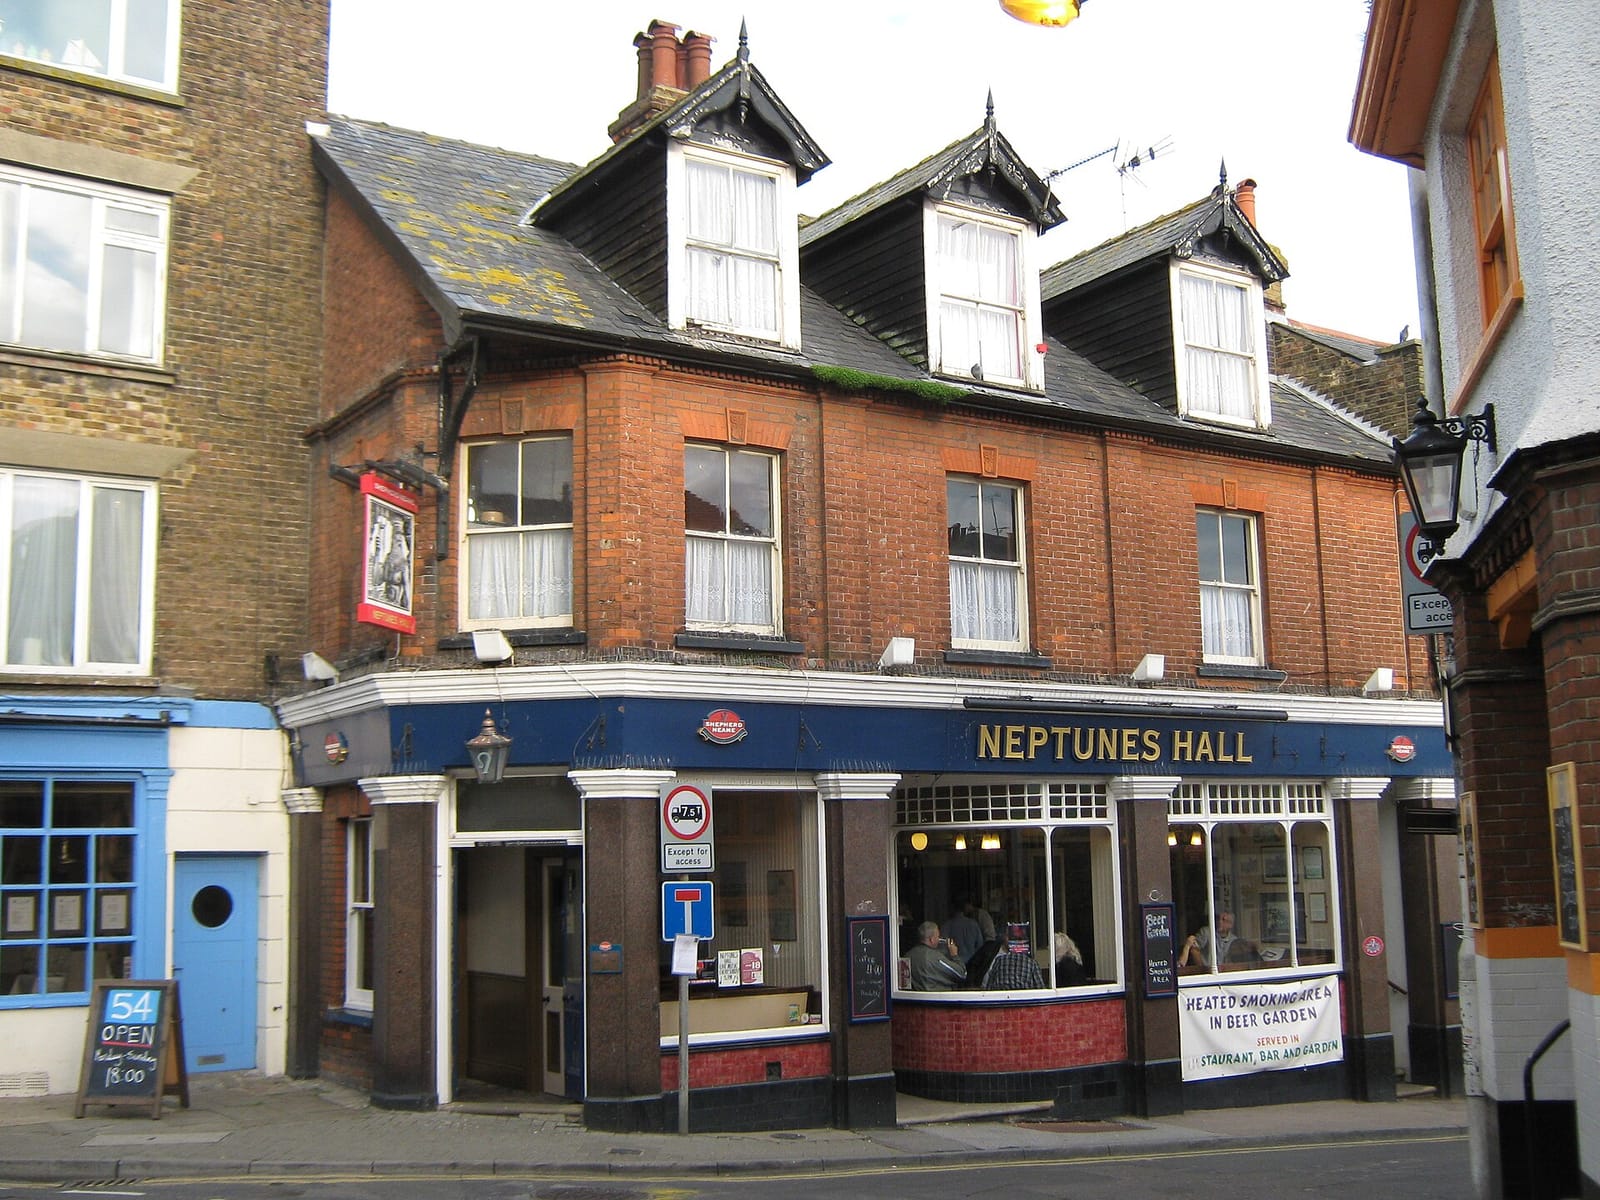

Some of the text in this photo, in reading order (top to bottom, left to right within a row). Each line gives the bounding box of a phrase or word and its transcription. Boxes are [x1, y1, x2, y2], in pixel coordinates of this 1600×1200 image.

[1413, 600, 1451, 610] Excep
[1425, 612, 1453, 622] acce
[977, 724, 1253, 763] NEPTUNES HALL
[667, 847, 694, 857] Except
[111, 992, 153, 1021] 54
[1186, 985, 1332, 1011] HEATED SMOKING AREA
[1210, 1006, 1318, 1030] IN BEER GARDEN
[101, 1025, 155, 1045] OPEN
[1256, 1034, 1300, 1047] SERVED IN
[1188, 1039, 1339, 1070] STAURANT, BAR AND GARDEN
